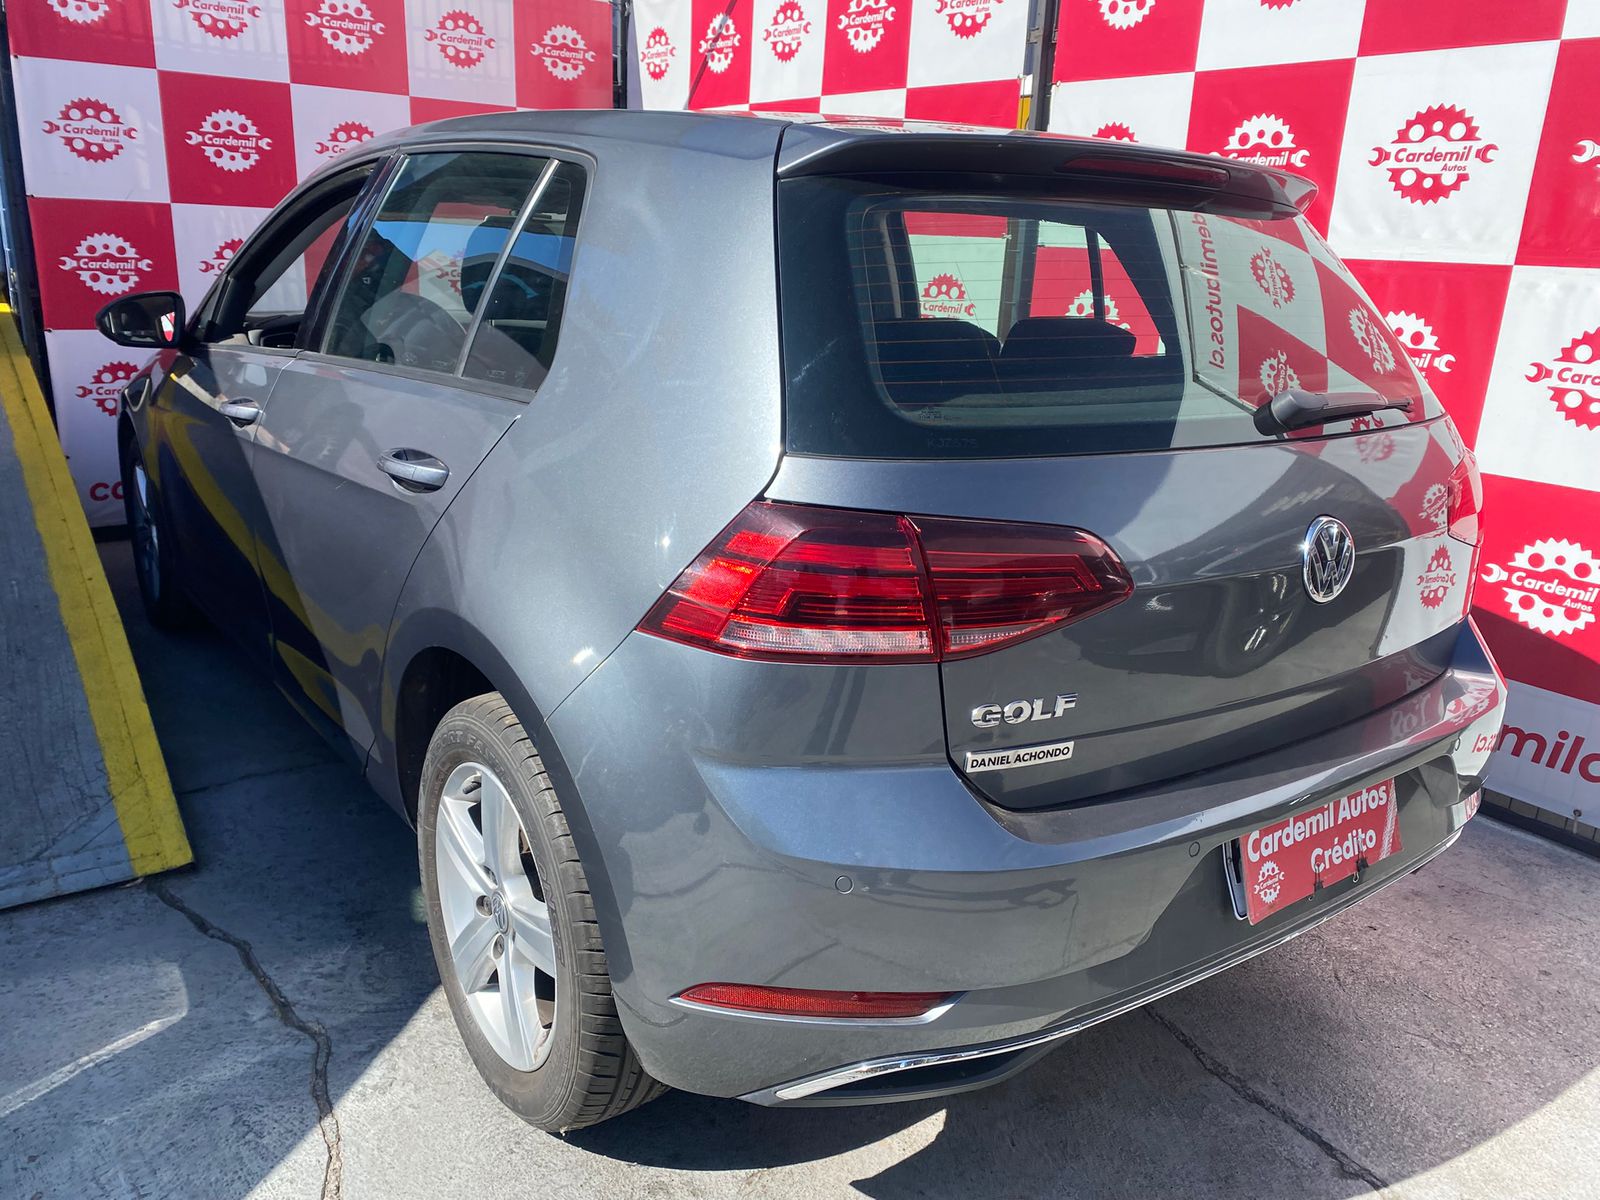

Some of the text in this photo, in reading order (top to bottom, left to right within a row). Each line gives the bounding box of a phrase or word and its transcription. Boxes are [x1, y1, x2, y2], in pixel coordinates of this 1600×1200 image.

[190, 1, 244, 15] Cardemil
[322, 16, 370, 31] Cardemil
[850, 10, 884, 26] Cardemil
[772, 24, 801, 38] Cardemil
[440, 32, 483, 46] Cardemil
[545, 46, 583, 59] Cardemil
[63, 123, 120, 138] Cardemil
[204, 134, 256, 147] Cardemil
[1394, 145, 1473, 163] Cardemil
[1441, 163, 1467, 172] Autos
[79, 258, 135, 270] Cardemil
[923, 302, 963, 314] Cardemil
[1511, 571, 1599, 603] Cardemil
[1563, 599, 1592, 612] Autos
[971, 693, 1078, 728] GOLF
[970, 746, 1070, 768] DANIEL ACHONDO
[1247, 785, 1388, 862] Cardemil Autos
[1311, 829, 1377, 873] Crédito
